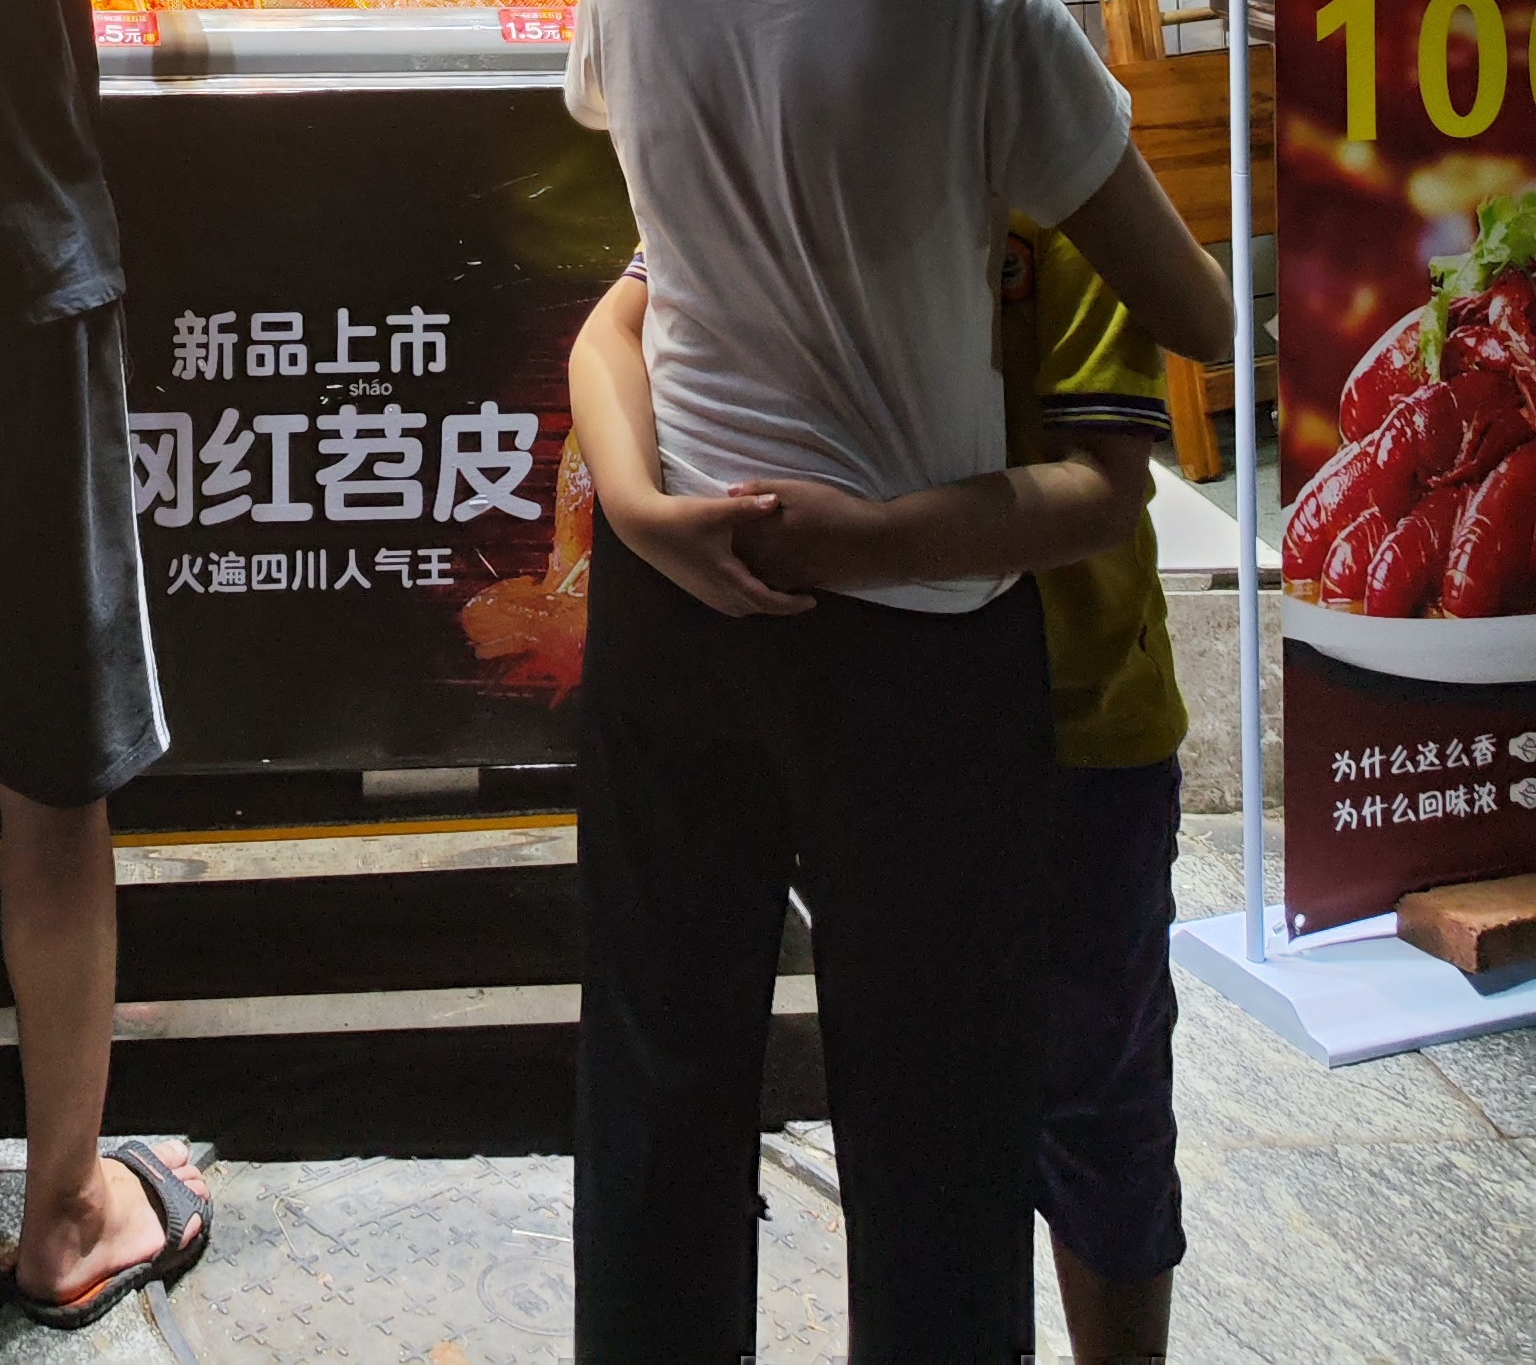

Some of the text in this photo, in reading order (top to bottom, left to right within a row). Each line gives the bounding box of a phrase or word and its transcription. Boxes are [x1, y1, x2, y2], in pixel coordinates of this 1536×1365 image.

[171, 306, 451, 380] 新品上市
[348, 379, 393, 397] sháo
[128, 401, 543, 528] 网红苕皮
[166, 547, 455, 596] 火遍四川人气王
[1331, 733, 1497, 783] 为什么这么香
[1332, 781, 1499, 832] 为什么回味浓
